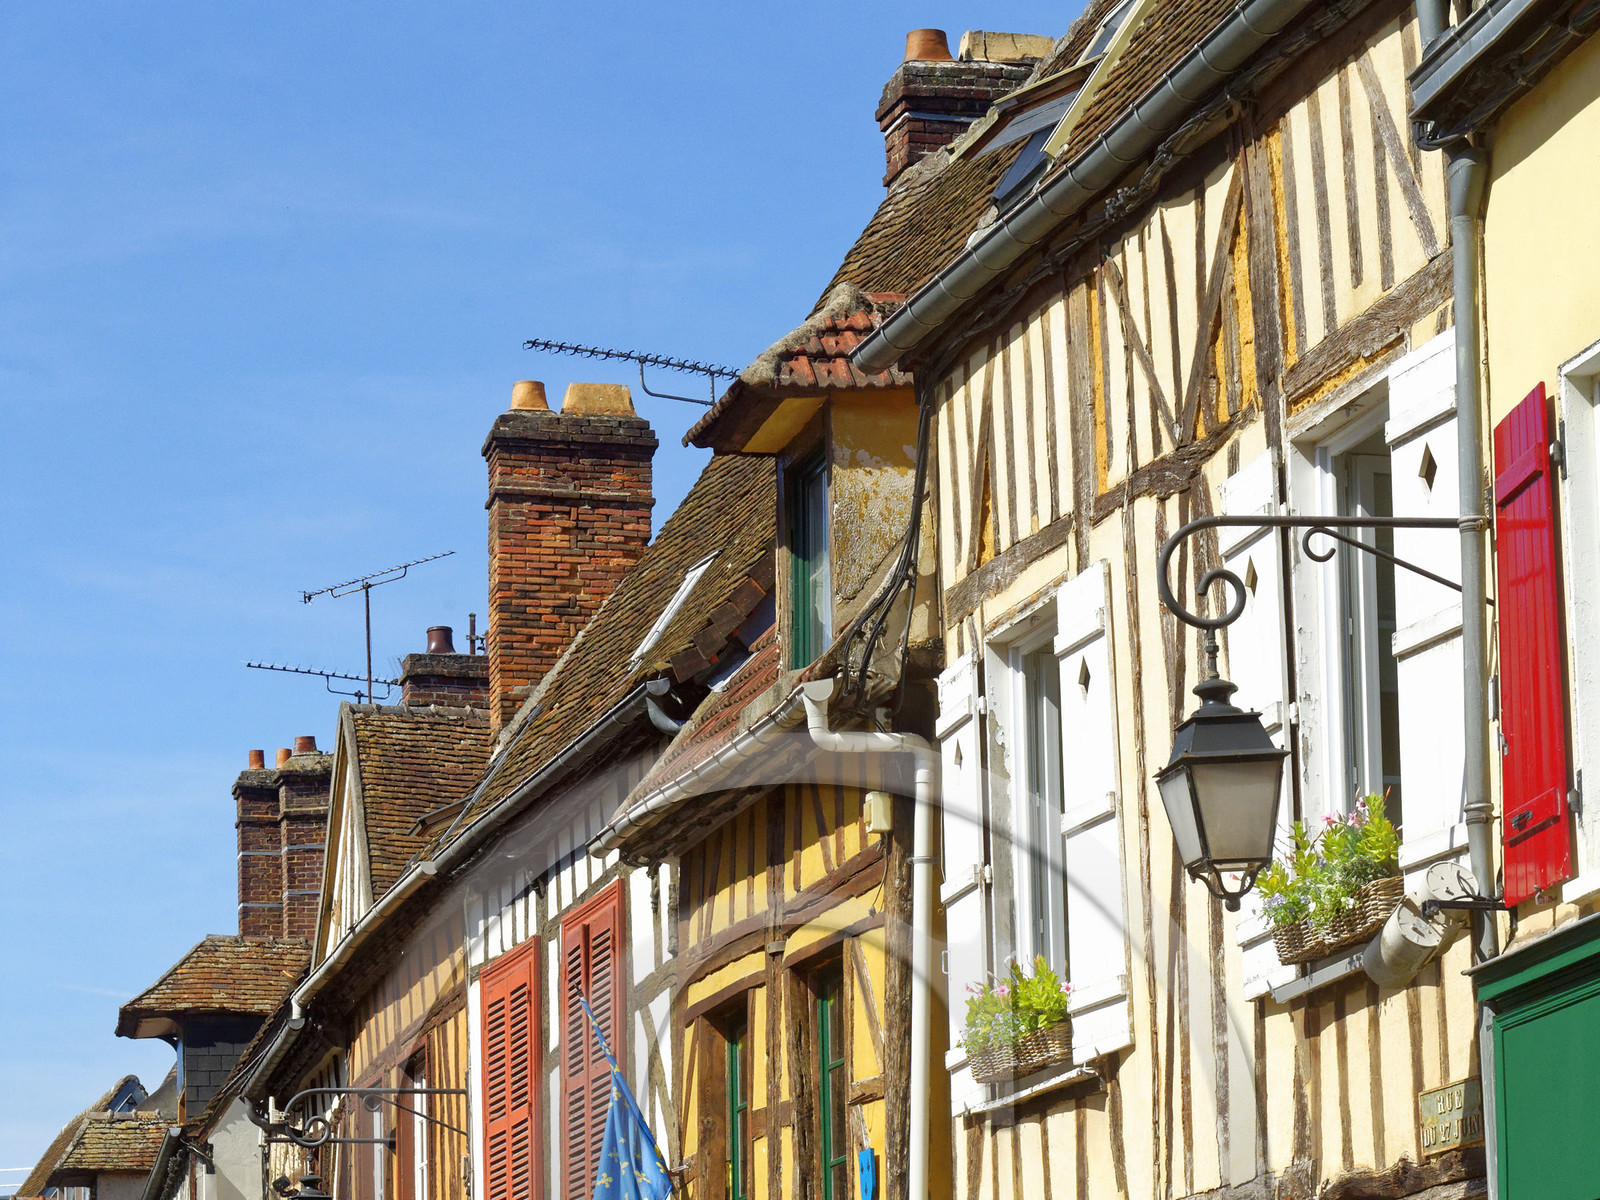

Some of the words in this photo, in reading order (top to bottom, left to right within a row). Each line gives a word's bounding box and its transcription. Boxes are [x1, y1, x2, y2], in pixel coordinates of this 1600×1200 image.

[1437, 1090, 1463, 1114] RUE
[1423, 1126, 1437, 1148] DU
[1439, 1121, 1451, 1143] 27
[1454, 1114, 1479, 1139] JUIN
